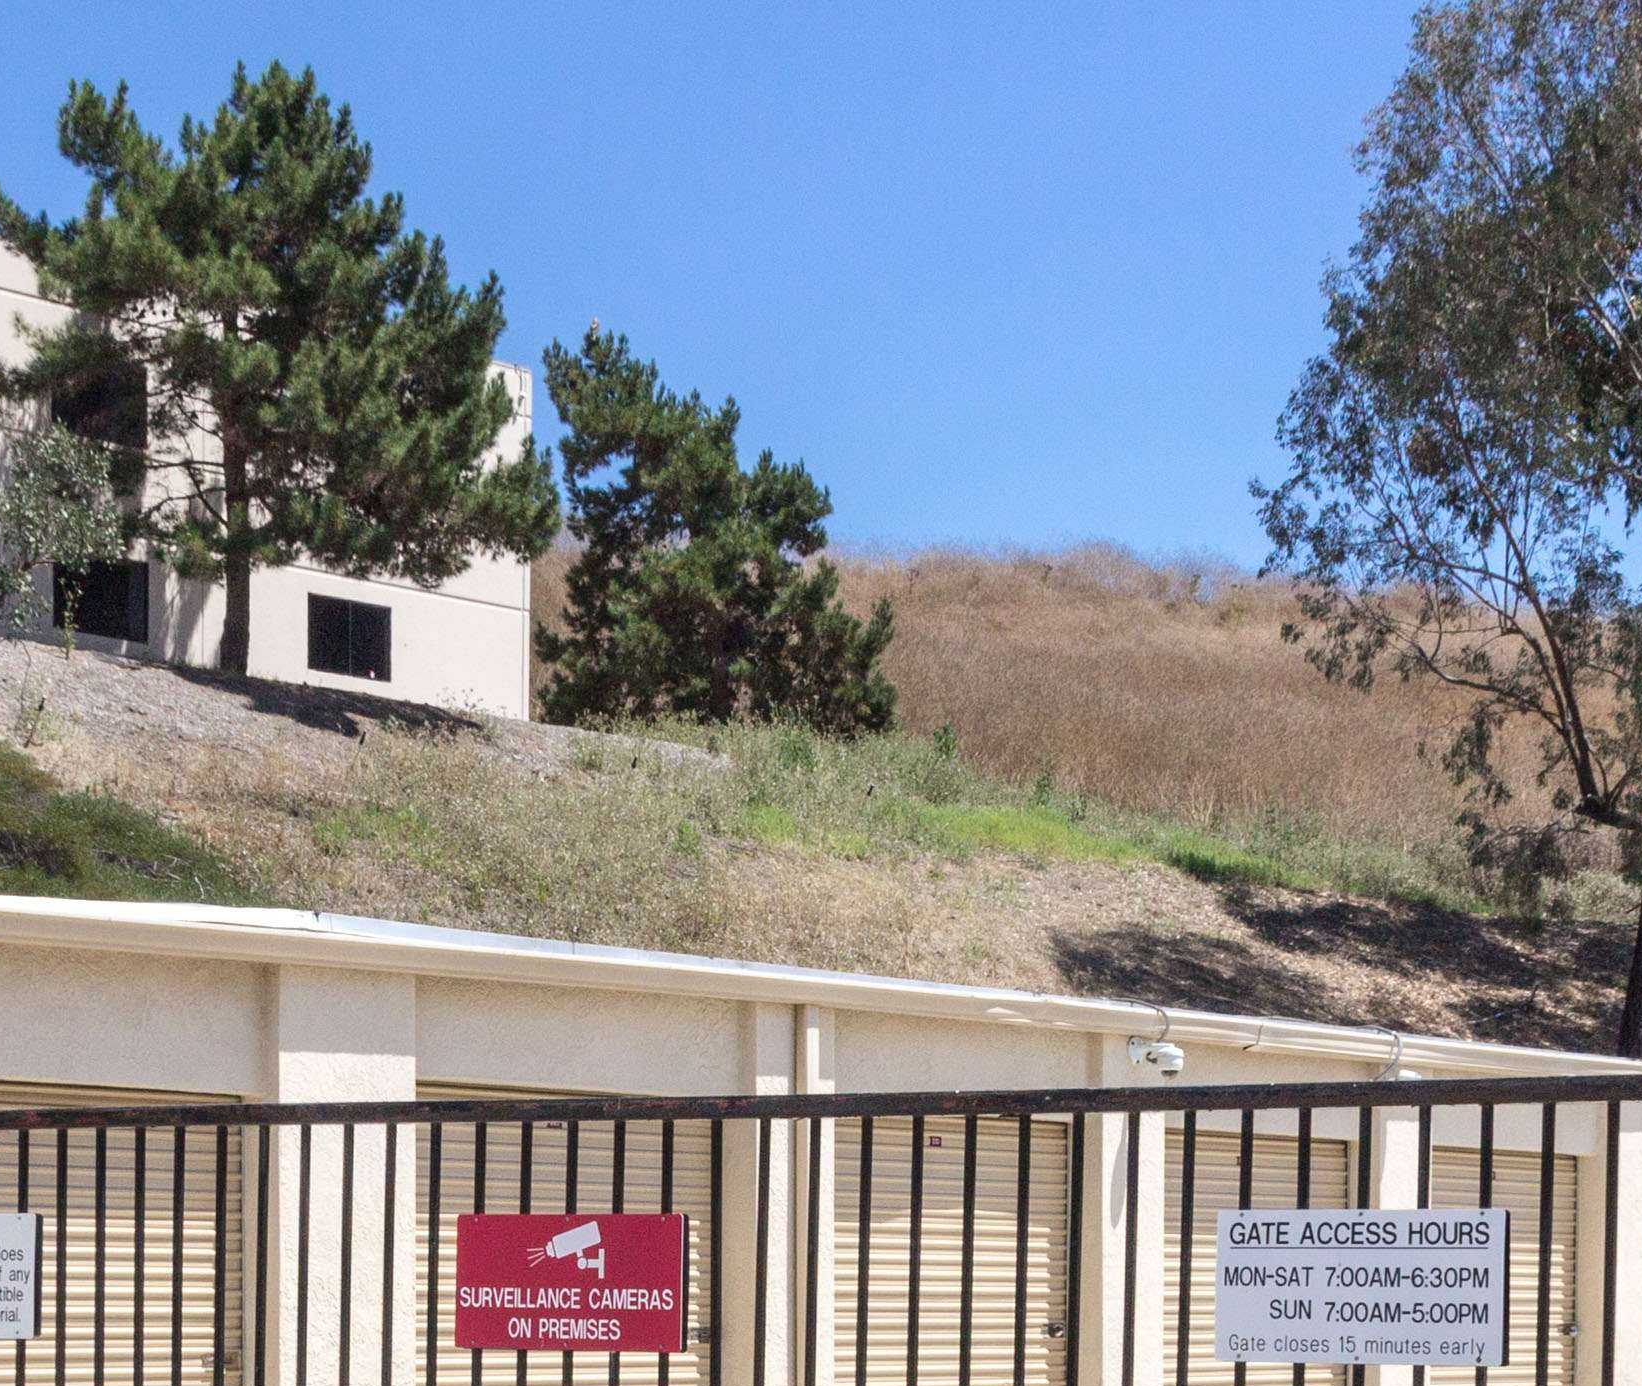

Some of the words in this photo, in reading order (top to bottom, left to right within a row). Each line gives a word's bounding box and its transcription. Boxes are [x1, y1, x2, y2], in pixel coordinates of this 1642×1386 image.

[1229, 1222, 1290, 1245] GATE
[1300, 1221, 1397, 1245] ACCESS
[1408, 1221, 1490, 1245] HOURS
[9, 1269, 30, 1284] any
[1223, 1266, 1313, 1288] MON-SAT
[1325, 1266, 1490, 1289] 7:00AM-6:30PM
[459, 1286, 581, 1310] SURVEILLANCE
[588, 1288, 674, 1310] CAMERAS
[1269, 1299, 1312, 1320] SUN
[1324, 1301, 1489, 1324] 7:00AM-5:00PM
[508, 1317, 531, 1339] ON
[538, 1318, 621, 1340] PREMISES
[1229, 1334, 1266, 1351] Gate
[1274, 1334, 1330, 1352] closes
[1339, 1335, 1356, 1353] 15
[1364, 1336, 1431, 1355] minutes
[1439, 1337, 1486, 1358] early
